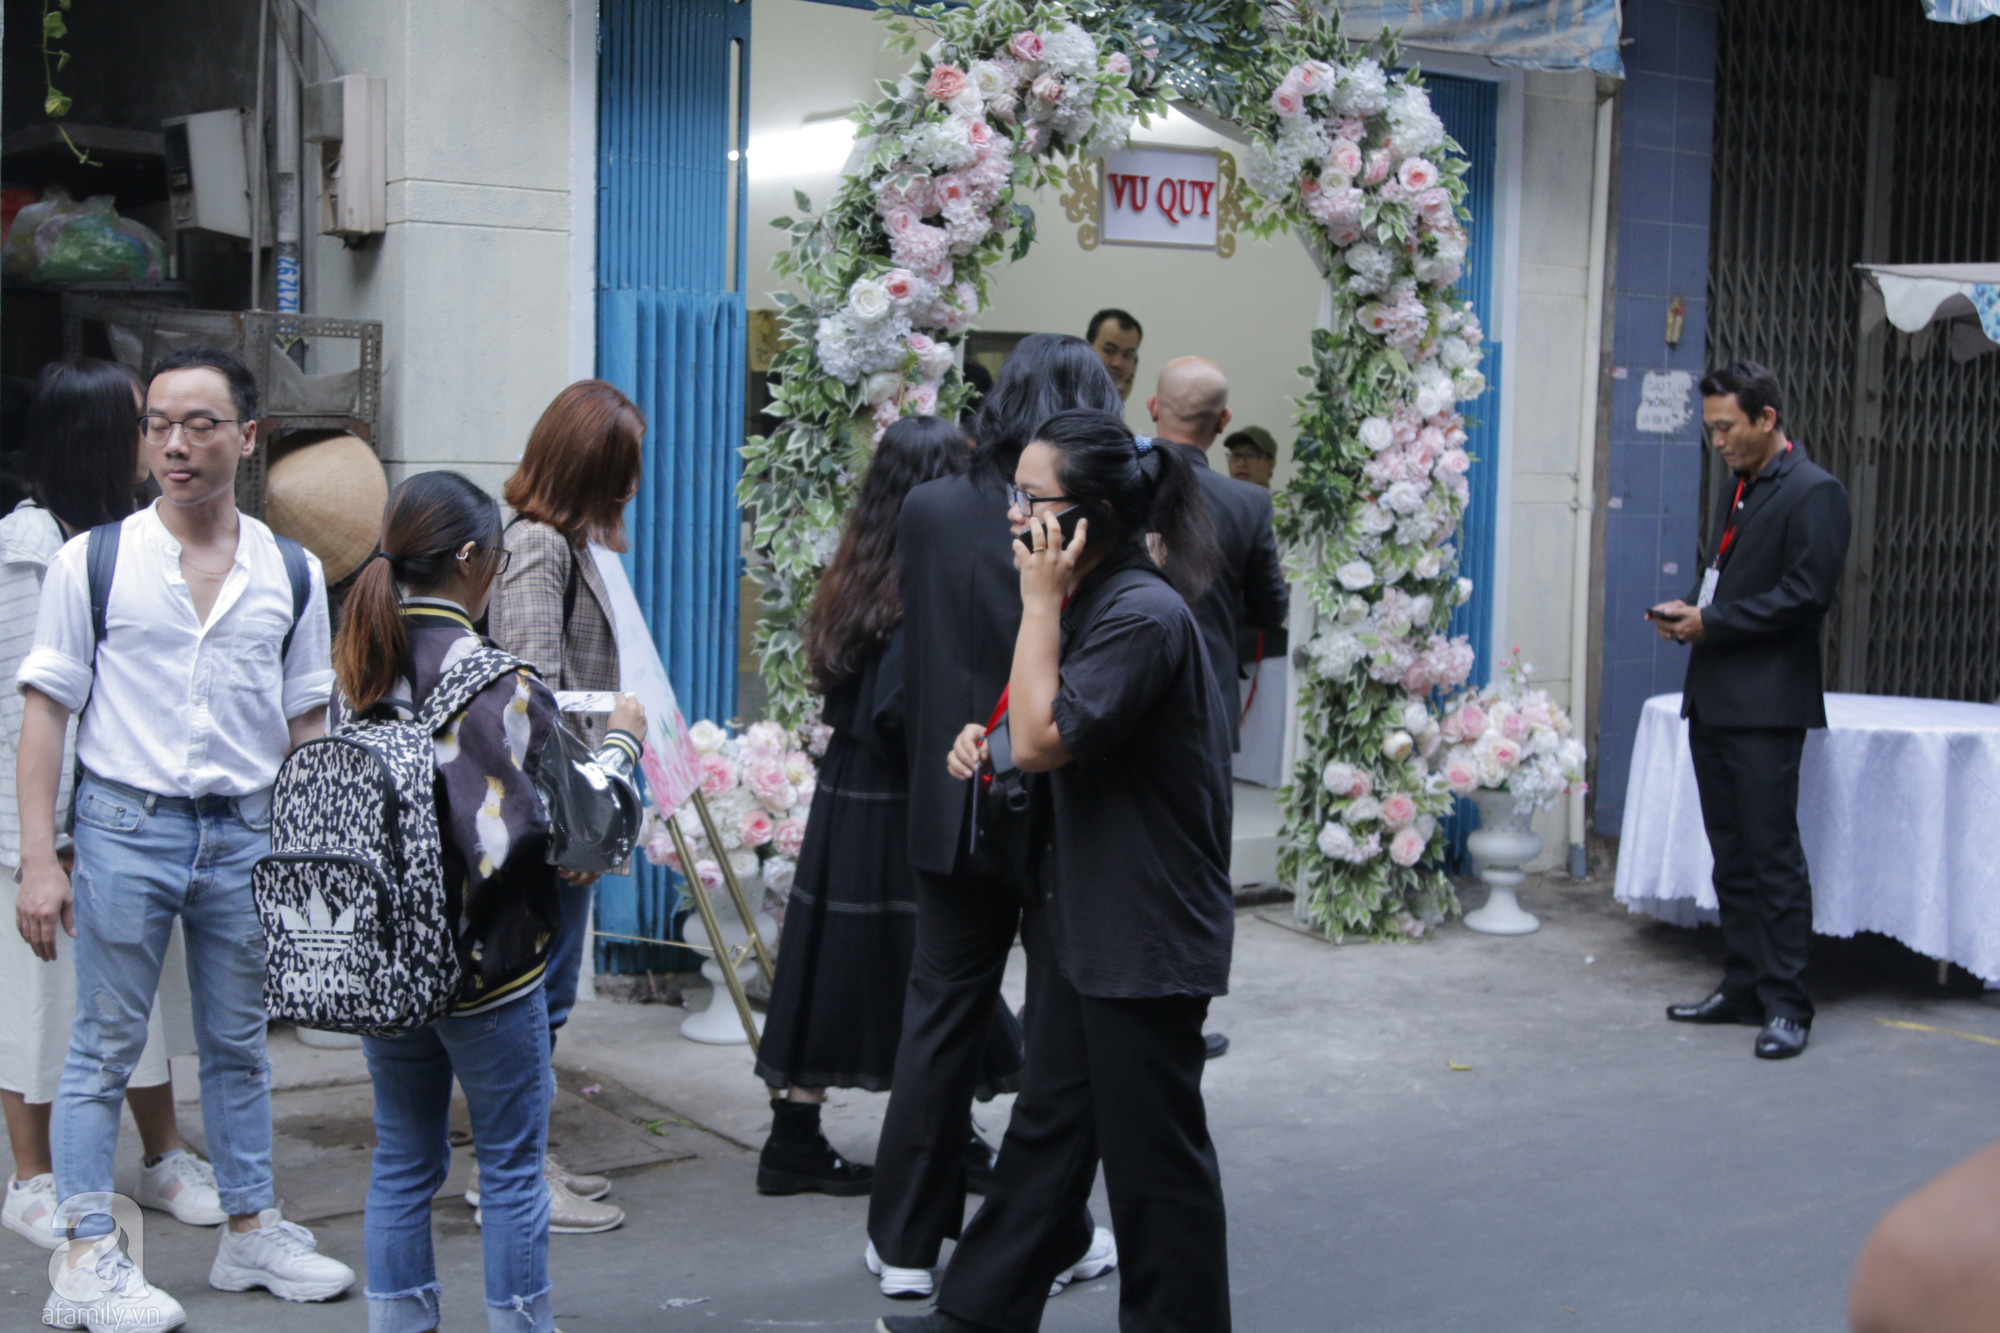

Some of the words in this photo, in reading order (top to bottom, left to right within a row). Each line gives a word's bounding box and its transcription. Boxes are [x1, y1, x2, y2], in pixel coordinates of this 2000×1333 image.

[1109, 173, 1150, 212] VU
[1157, 178, 1216, 224] QUY
[281, 966, 364, 995] adidas
